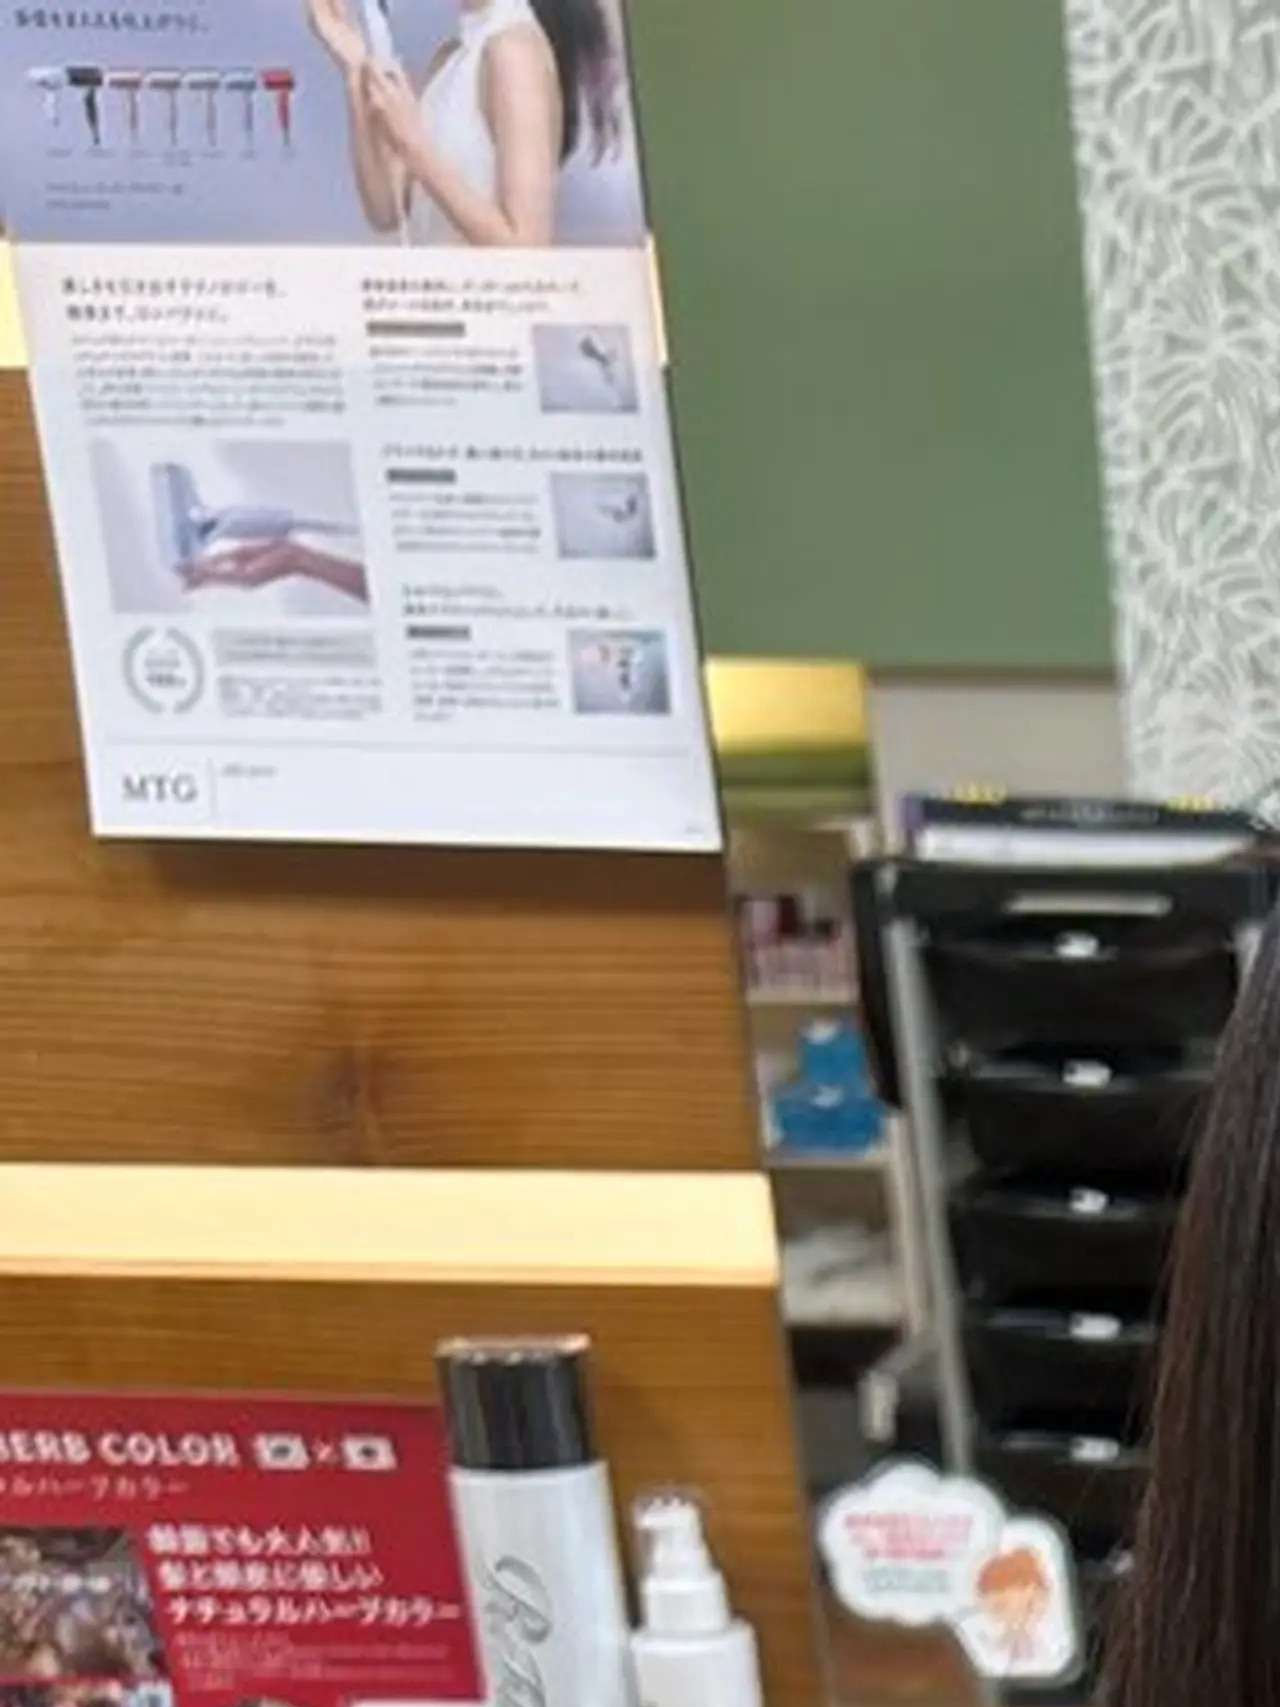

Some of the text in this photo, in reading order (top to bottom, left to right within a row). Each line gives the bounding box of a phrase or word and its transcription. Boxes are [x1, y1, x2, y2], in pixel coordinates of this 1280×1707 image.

[121, 774, 198, 803] MTG
[98, 1431, 241, 1467] COLOR
[167, 1596, 461, 1627] ナチュラルハーブカラー
